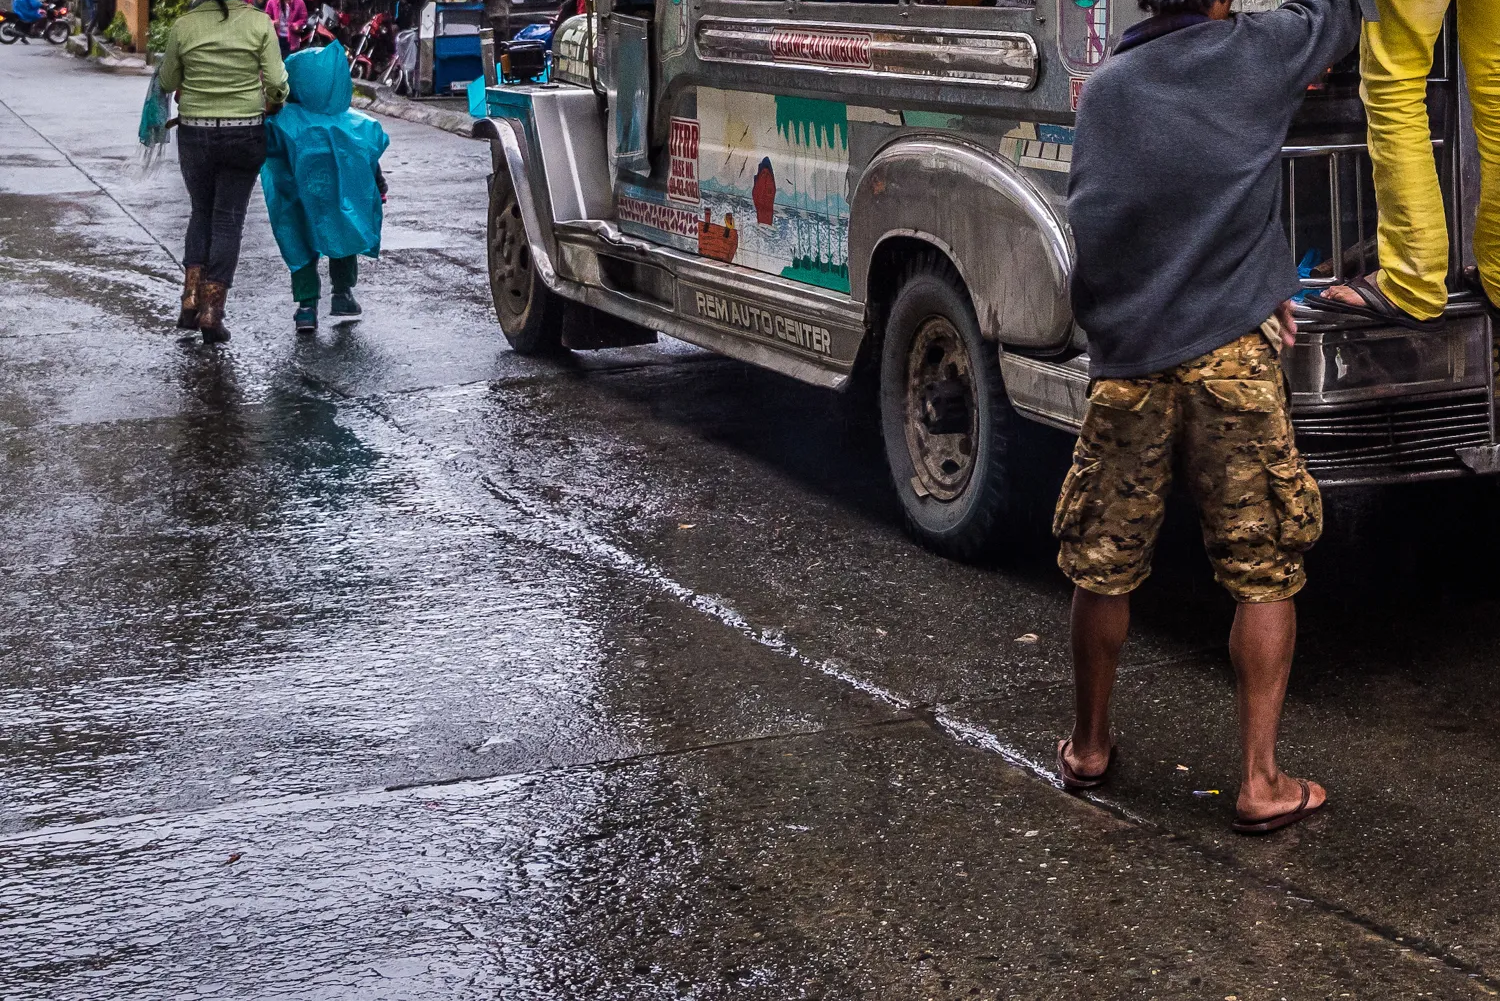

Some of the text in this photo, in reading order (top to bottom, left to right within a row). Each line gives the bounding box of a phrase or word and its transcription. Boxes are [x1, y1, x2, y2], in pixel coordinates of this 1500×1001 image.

[670, 122, 699, 159] LTFRB
[695, 291, 831, 354] REM AUTO CENTER
